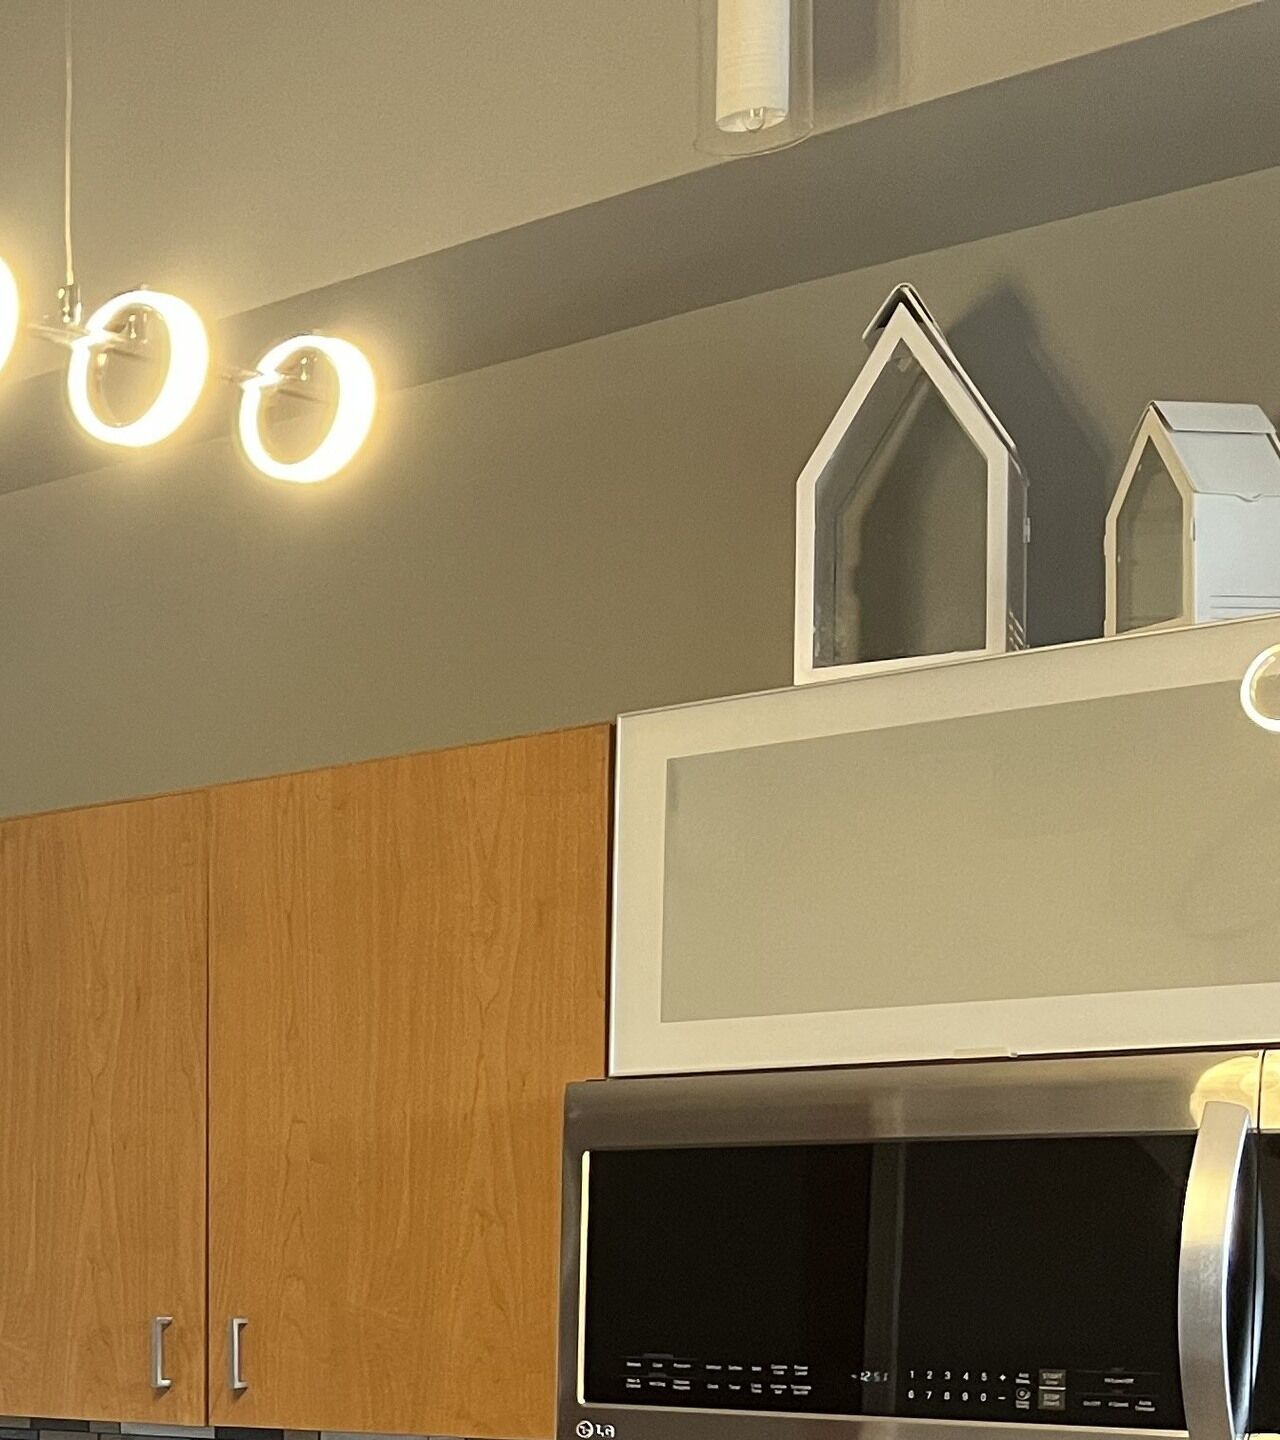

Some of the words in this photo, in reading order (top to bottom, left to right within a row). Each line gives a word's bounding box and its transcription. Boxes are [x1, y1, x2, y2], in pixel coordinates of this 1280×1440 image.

[910, 1370, 915, 1379] 1
[927, 1370, 933, 1380] 2
[944, 1371, 951, 1380] 3
[962, 1372, 969, 1381] 4
[981, 1372, 987, 1381] 5
[908, 1390, 915, 1399] 6
[926, 1390, 933, 1399] 7
[944, 1391, 950, 1400] 8
[962, 1391, 969, 1401] 9
[980, 1392, 987, 1402] 0
